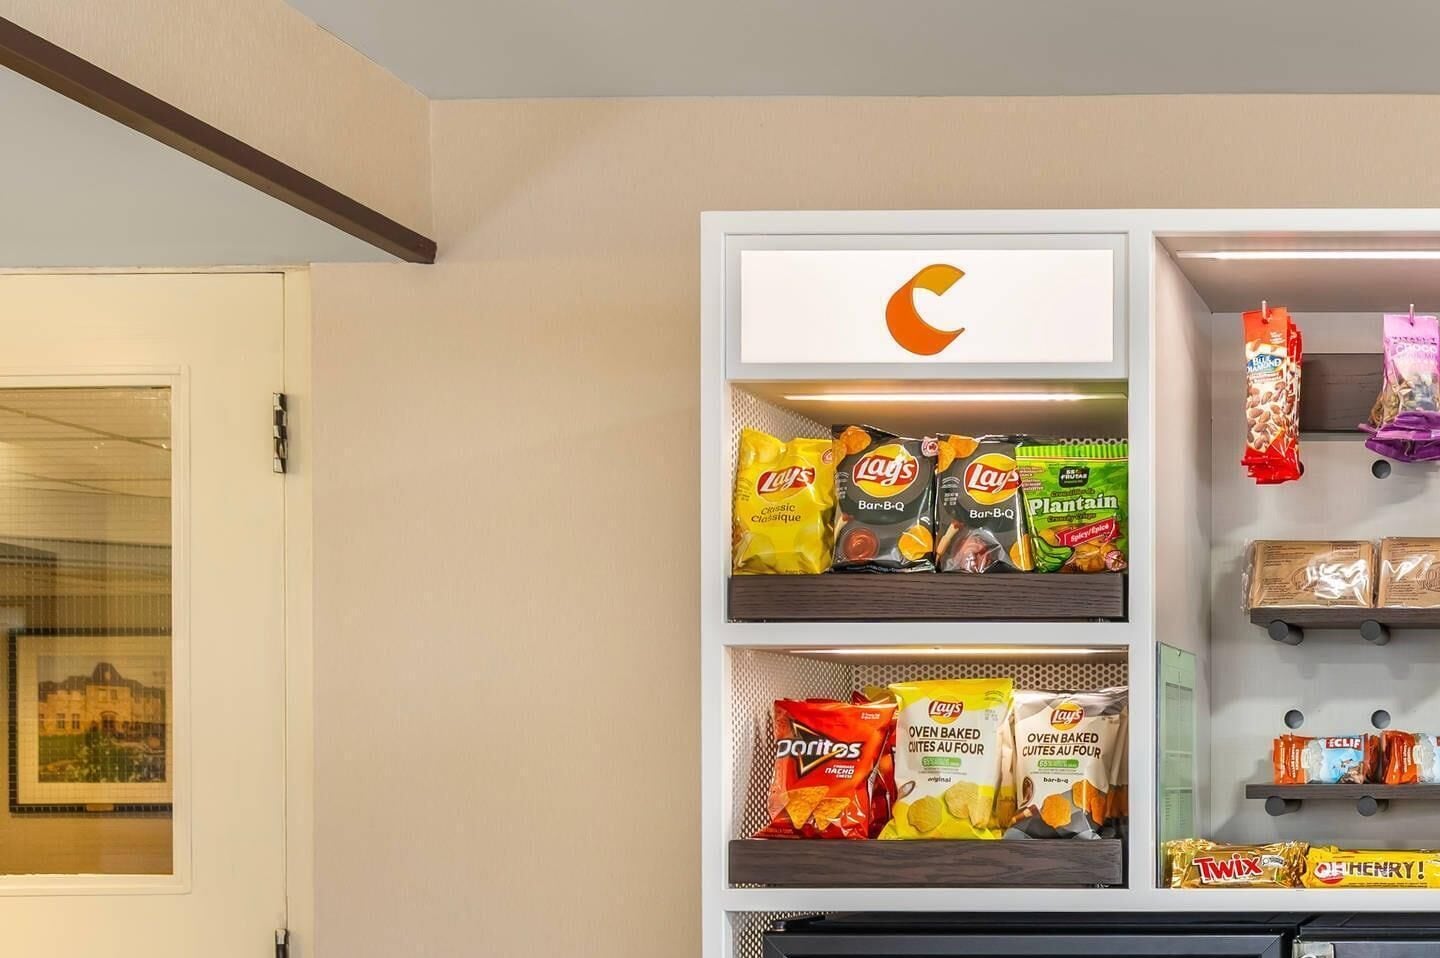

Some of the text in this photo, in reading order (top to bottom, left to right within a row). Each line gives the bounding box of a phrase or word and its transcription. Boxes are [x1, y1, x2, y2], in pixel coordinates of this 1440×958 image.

[1031, 493, 1118, 516] Plantain
[909, 726, 981, 740] OVEN BAKED
[1027, 732, 1099, 743] OVEN BAKED
[776, 739, 863, 759] Doritos
[937, 741, 953, 753] AU
[954, 742, 985, 755] FOUR
[1334, 738, 1361, 748] CLIF
[1022, 745, 1101, 759] CUITES AU FOUR
